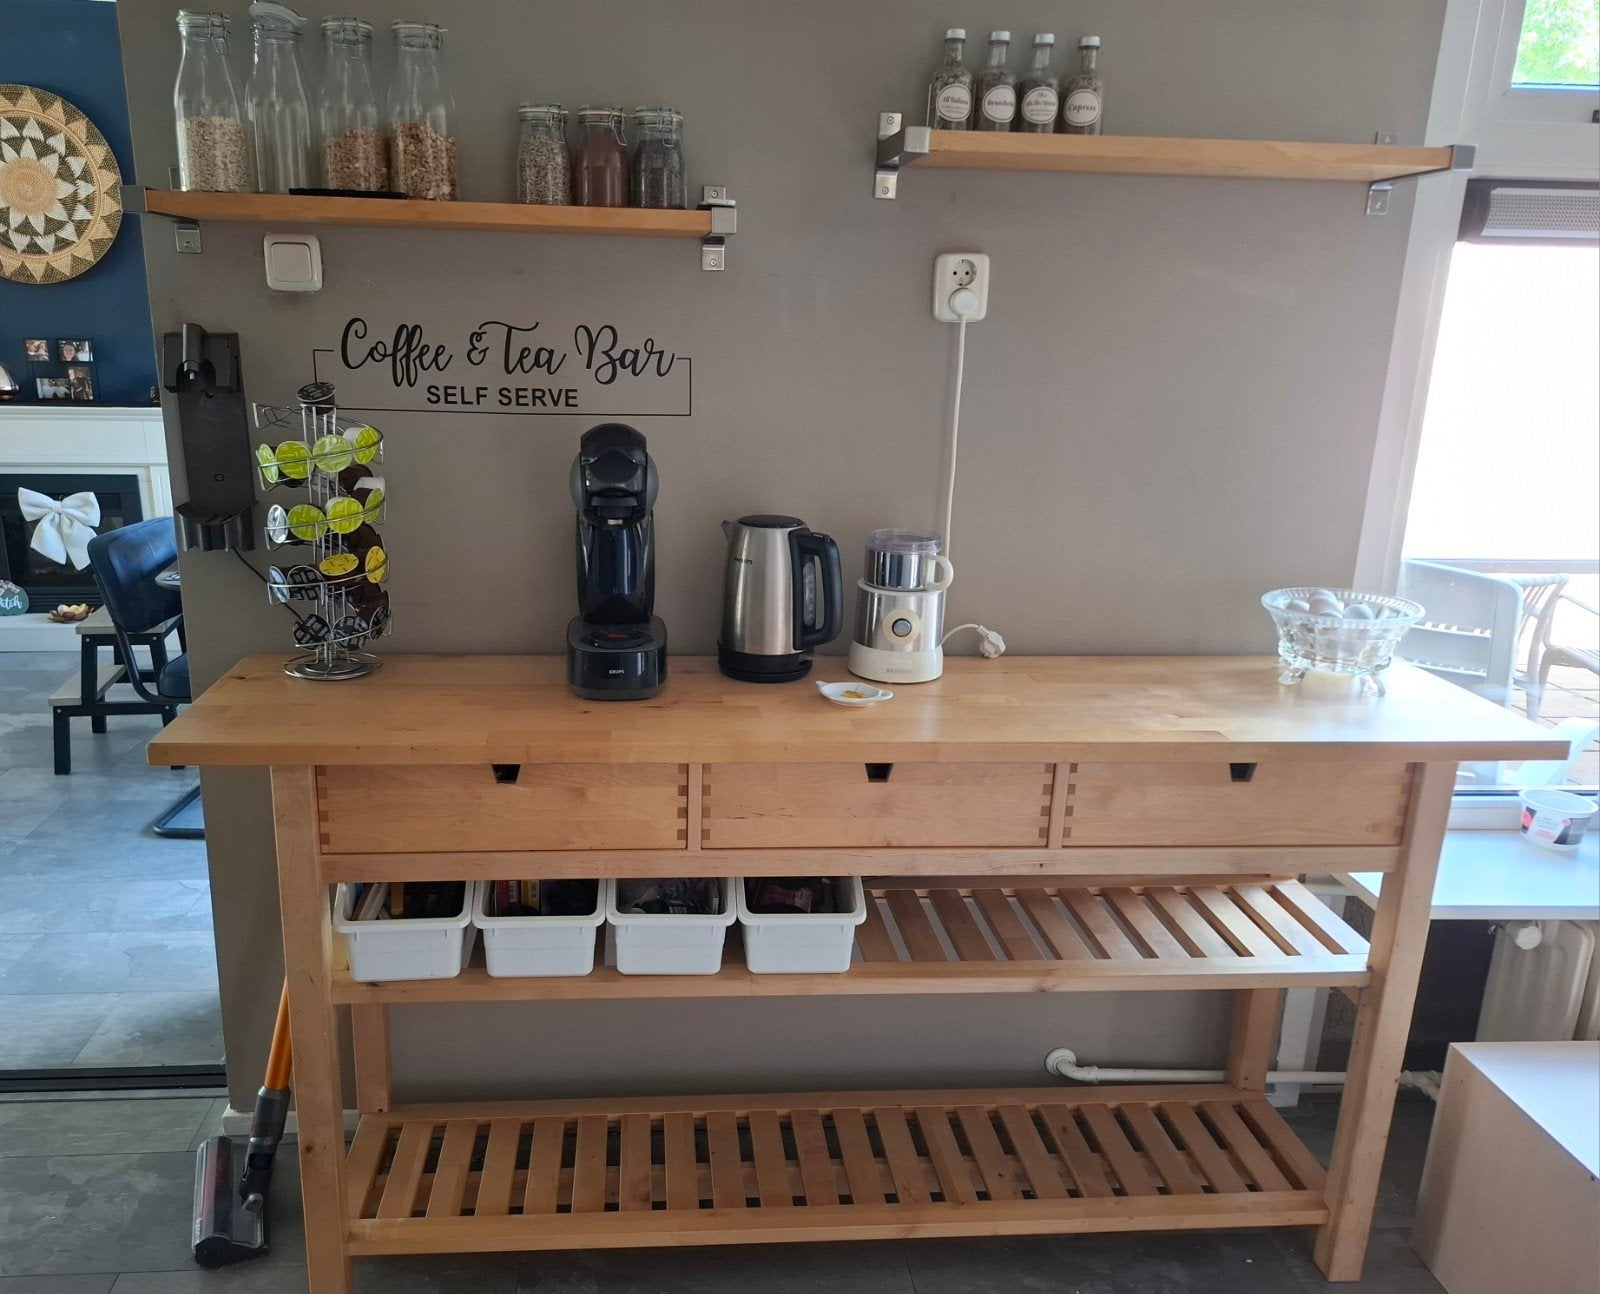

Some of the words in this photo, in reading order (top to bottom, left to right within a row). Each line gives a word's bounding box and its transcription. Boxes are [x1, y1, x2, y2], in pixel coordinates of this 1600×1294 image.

[341, 317, 452, 388] Coffee
[466, 330, 489, 366] &
[479, 321, 566, 374] Tea
[574, 324, 675, 384] Bar
[426, 385, 488, 406] SELF
[498, 387, 579, 408] SERVE
